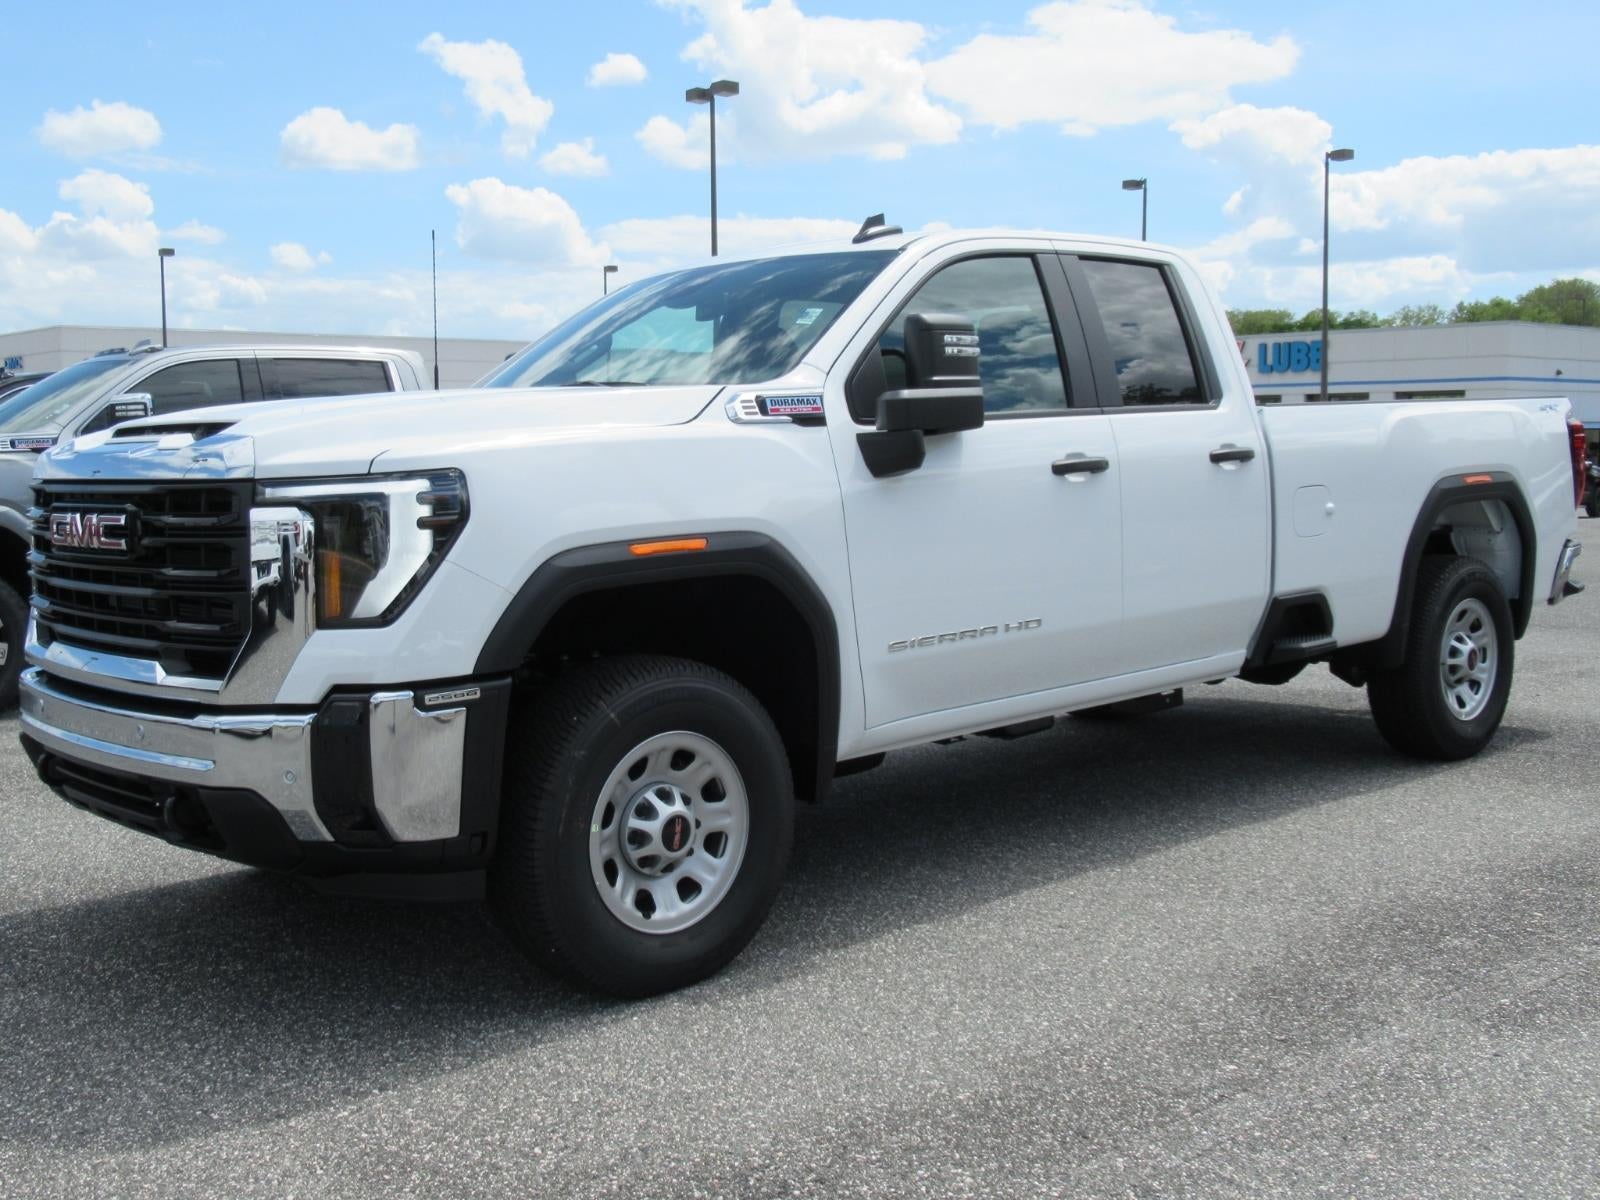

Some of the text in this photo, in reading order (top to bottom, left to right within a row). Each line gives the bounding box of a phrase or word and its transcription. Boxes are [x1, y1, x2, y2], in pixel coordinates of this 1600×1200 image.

[1258, 340, 1322, 373] LUBE
[769, 398, 818, 407] DURAMAX
[50, 513, 127, 550] GMC
[888, 618, 1042, 653] SIERRA HD
